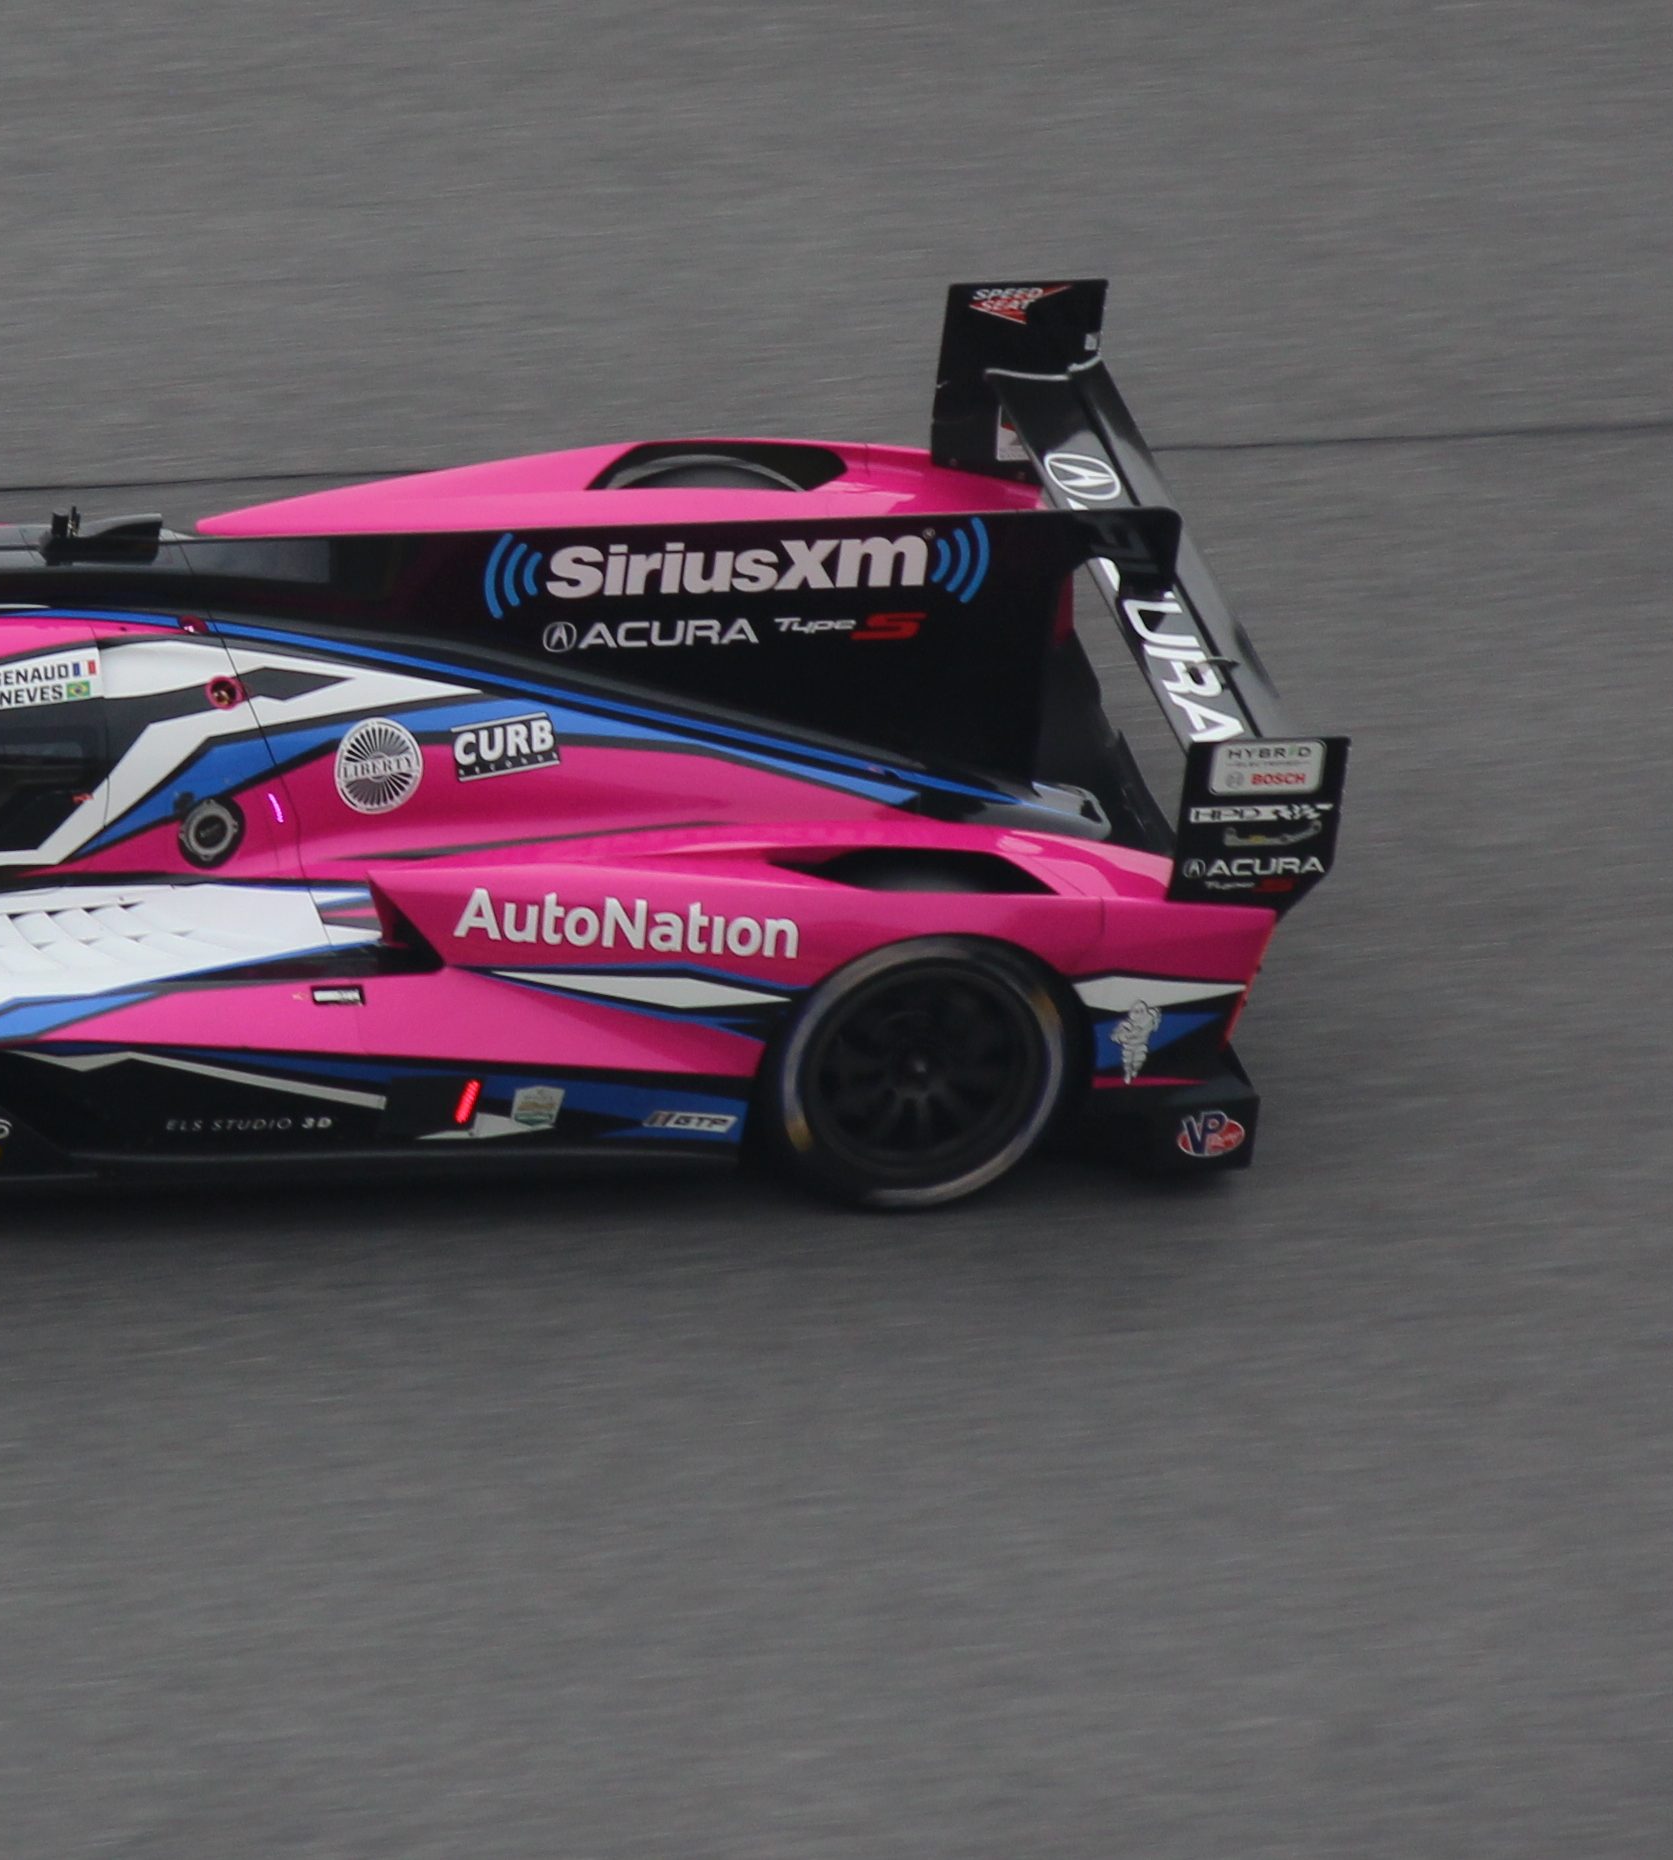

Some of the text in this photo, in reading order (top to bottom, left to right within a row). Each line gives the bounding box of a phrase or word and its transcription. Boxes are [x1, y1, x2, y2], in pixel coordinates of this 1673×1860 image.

[578, 612, 928, 650] ACURA Type S
[454, 719, 555, 766] CURB
[343, 753, 415, 779] LIBERTY
[1251, 772, 1306, 785] BOSCH
[1206, 856, 1326, 877] ACURA
[454, 888, 799, 959] AutoNation
[166, 1118, 204, 1131] ELS
[211, 1117, 292, 1131] STUDIO
[673, 1115, 729, 1128] GTP
[1182, 1111, 1229, 1155] VP
